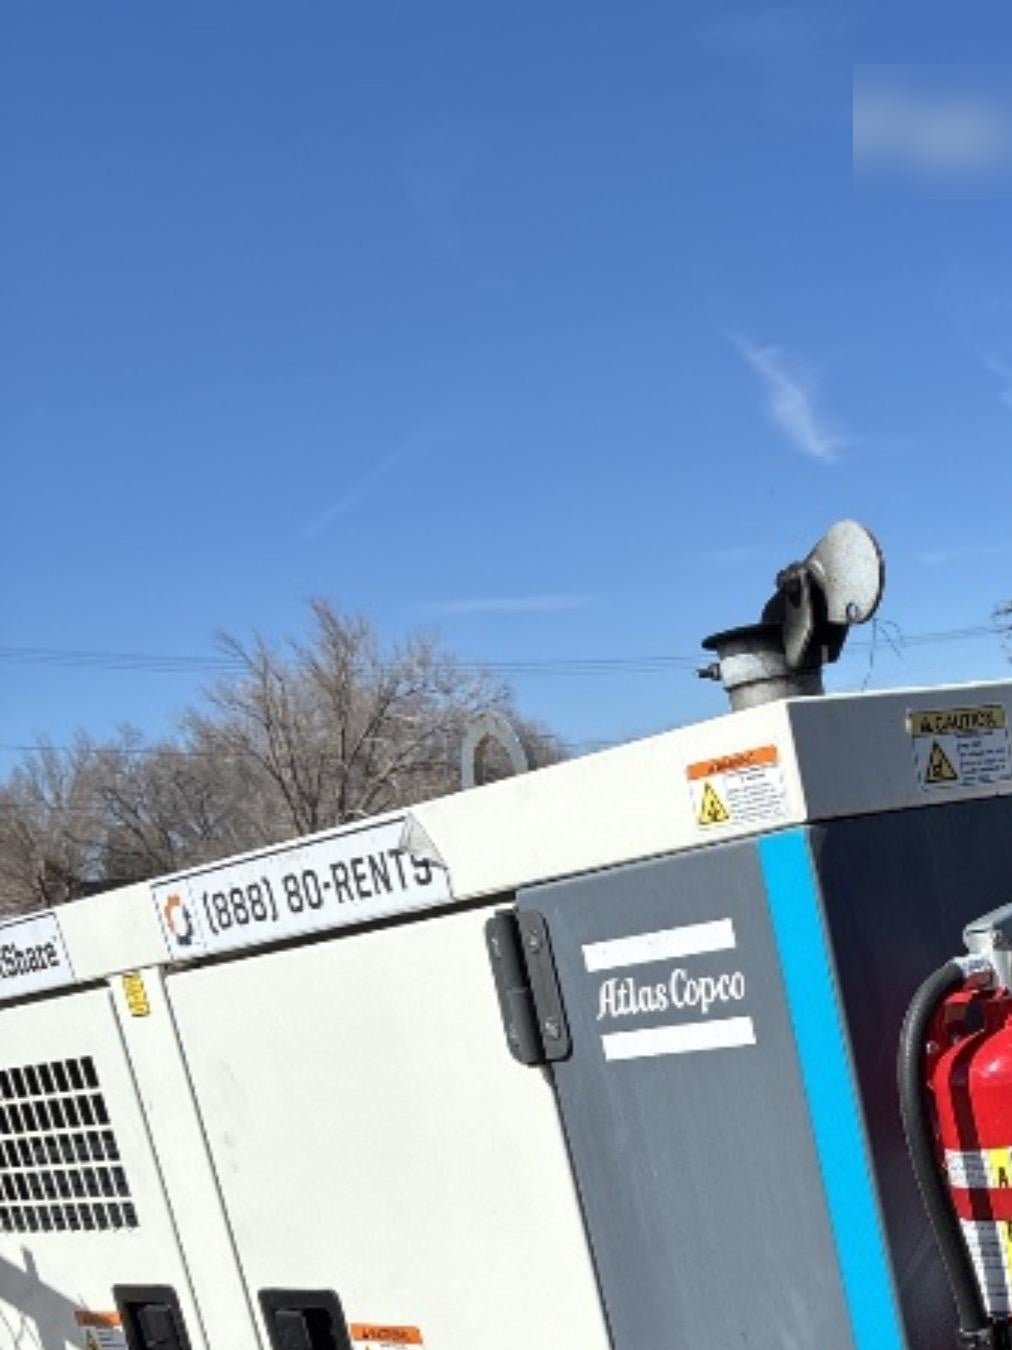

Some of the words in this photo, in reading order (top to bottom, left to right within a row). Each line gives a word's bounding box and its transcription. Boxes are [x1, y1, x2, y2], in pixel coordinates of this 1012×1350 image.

[202, 876, 280, 936] (888)
[0, 941, 60, 979] Share
[596, 975, 669, 1021] Atlas
[669, 968, 745, 1015] Copco
